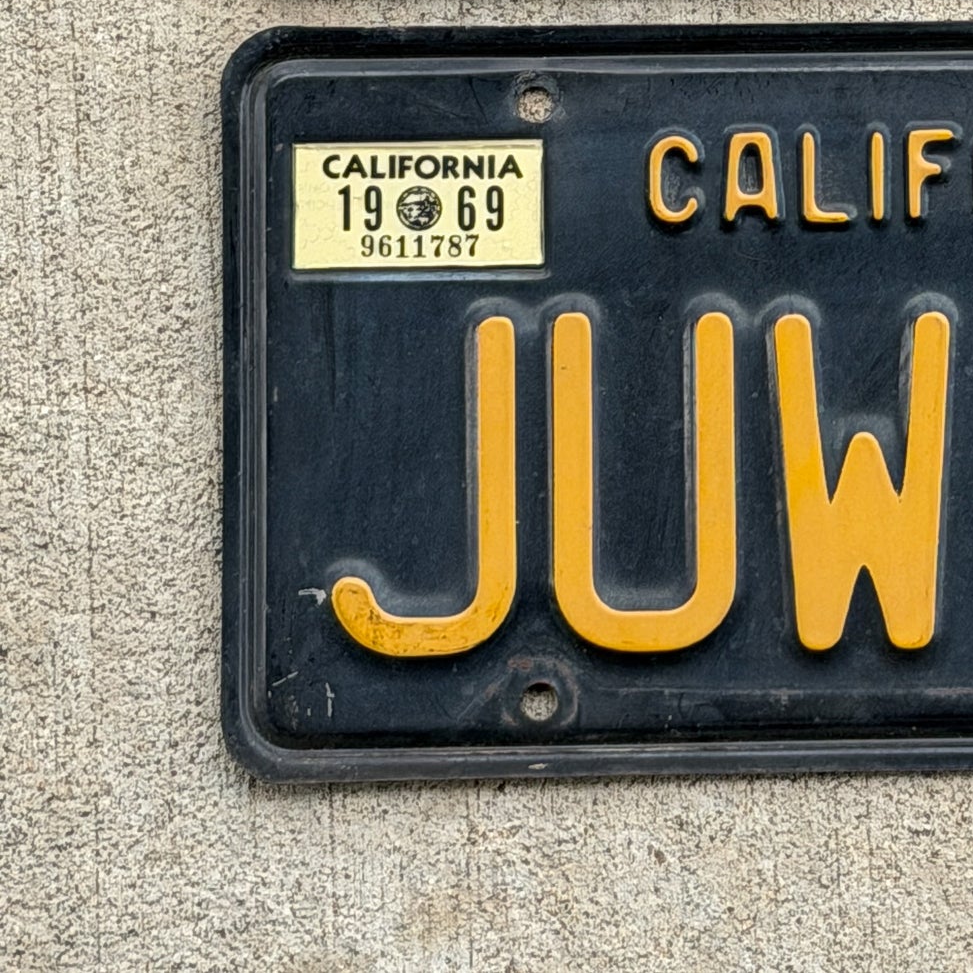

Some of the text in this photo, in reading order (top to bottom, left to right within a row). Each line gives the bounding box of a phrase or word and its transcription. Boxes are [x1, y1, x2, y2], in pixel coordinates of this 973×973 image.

[322, 154, 524, 180] CALIFORNIA
[338, 184, 505, 232] 19 69
[360, 234, 479, 259] 9611787
[329, 310, 952, 659] JUW
